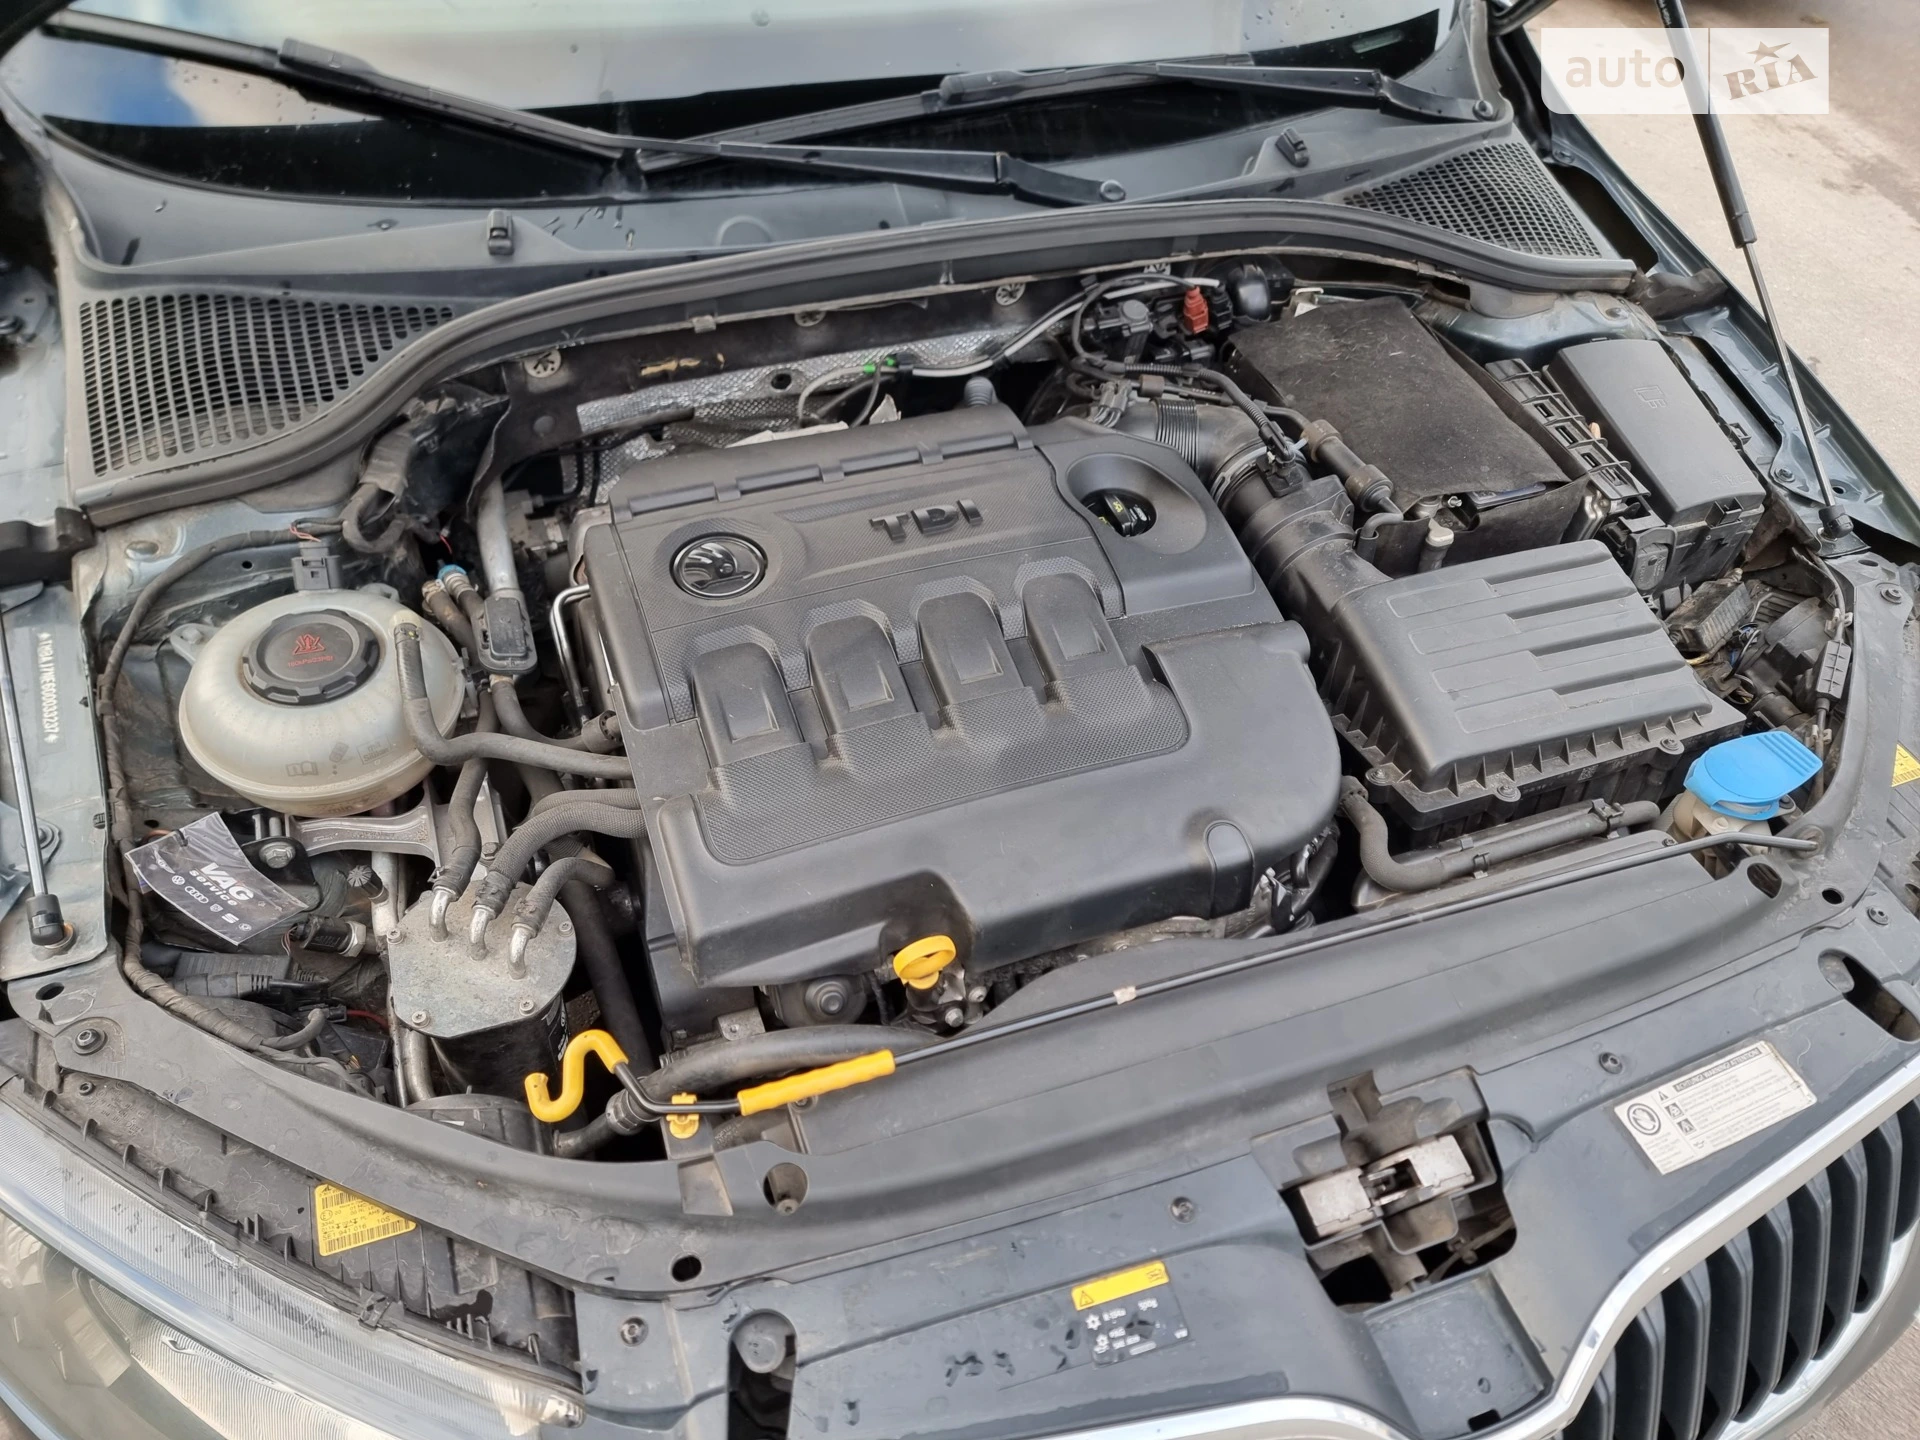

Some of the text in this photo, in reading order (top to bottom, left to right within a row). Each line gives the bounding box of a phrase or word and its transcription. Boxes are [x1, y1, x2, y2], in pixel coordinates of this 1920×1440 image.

[868, 499, 984, 542] TDI
[189, 869, 238, 906] service
[200, 862, 254, 901] VAG
